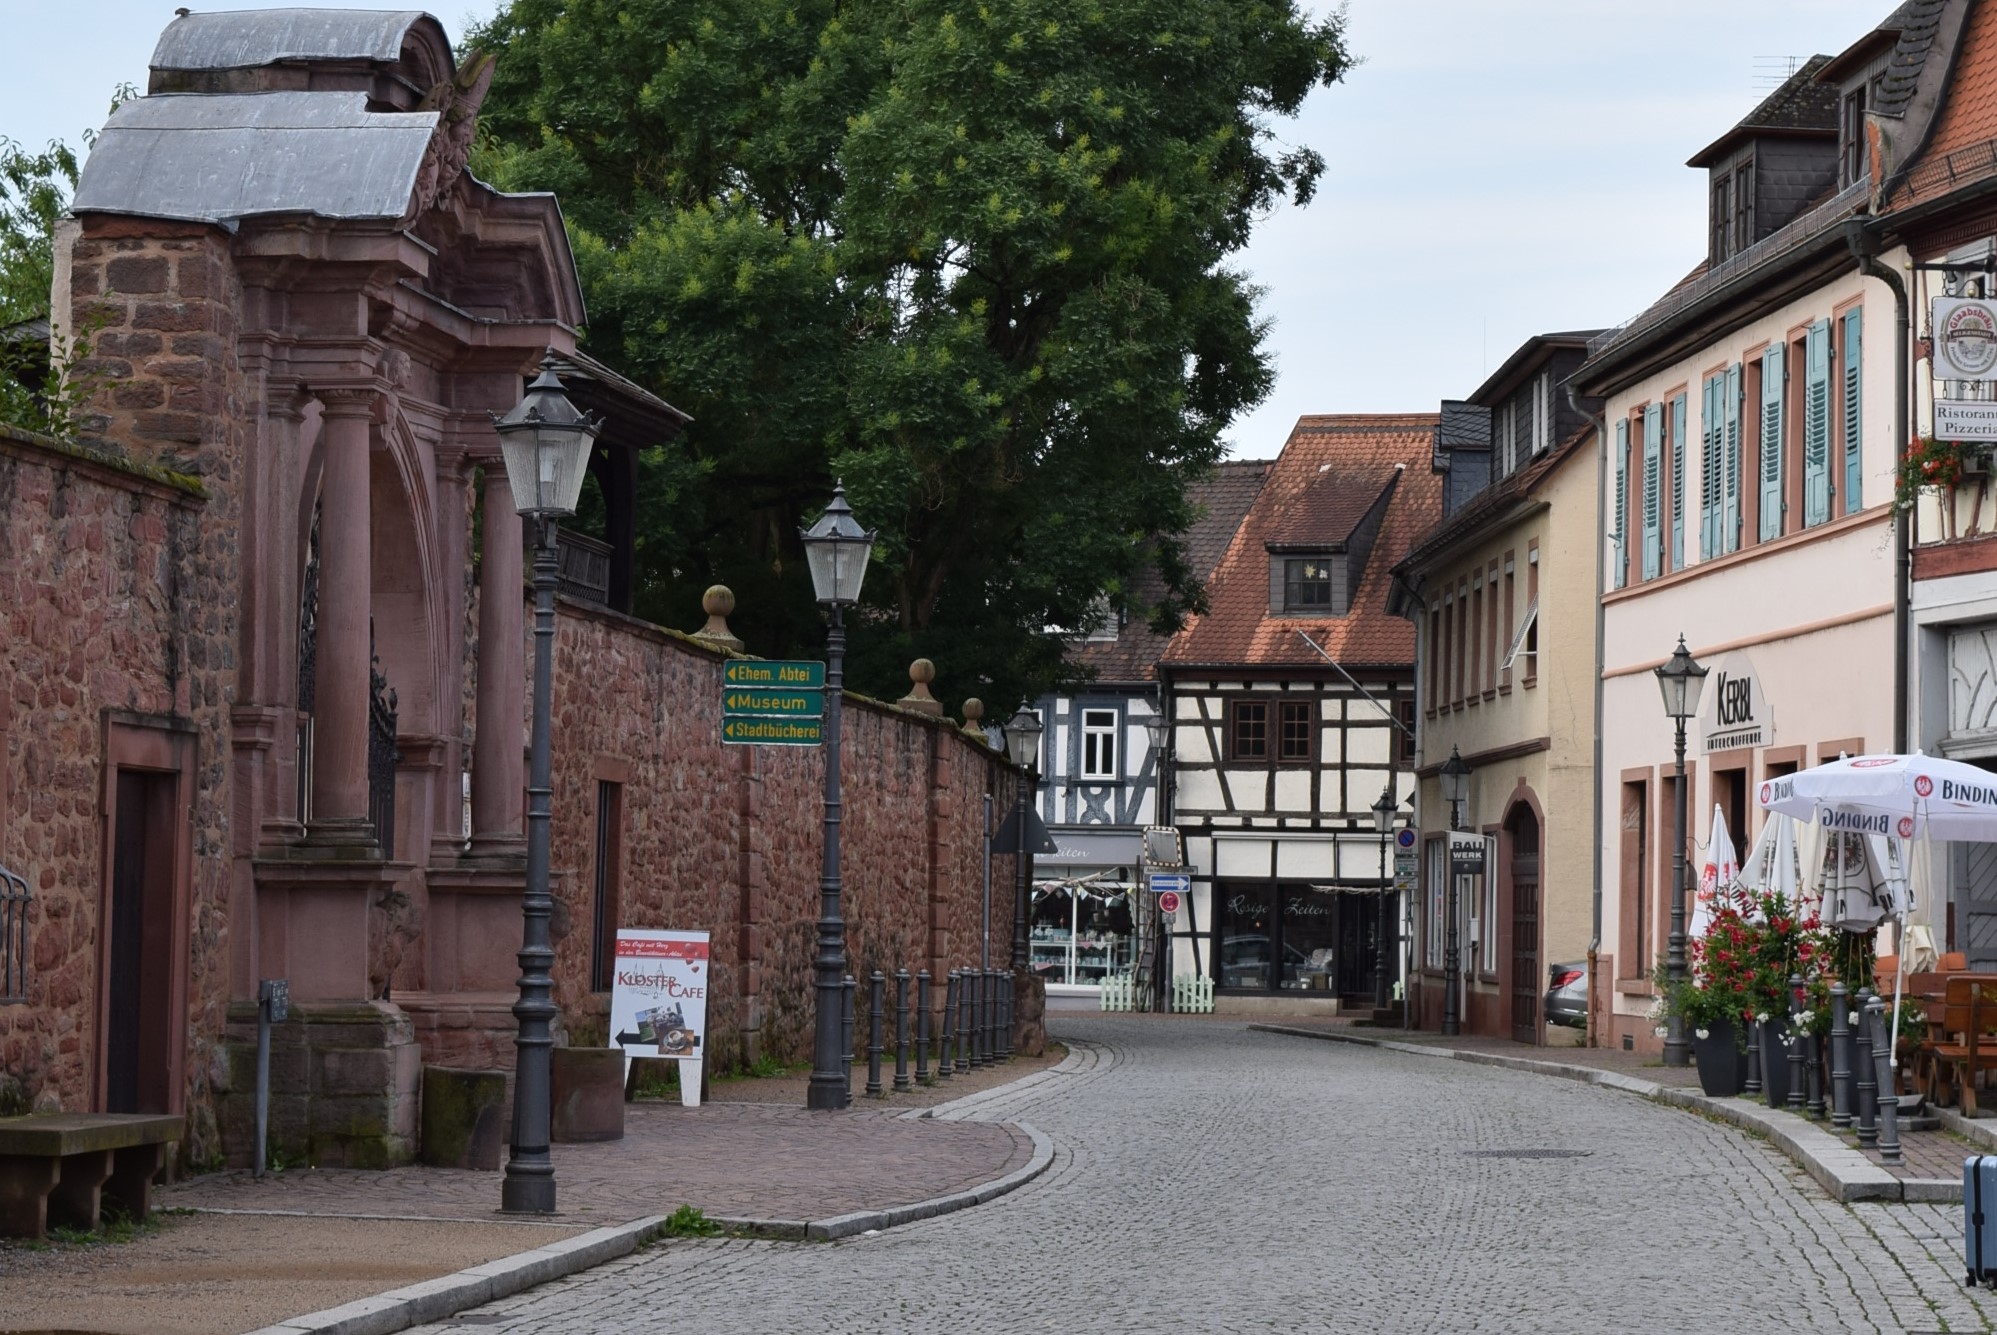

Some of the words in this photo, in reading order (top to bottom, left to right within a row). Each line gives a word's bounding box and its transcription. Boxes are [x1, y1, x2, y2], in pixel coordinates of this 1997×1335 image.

[1950, 307, 1993, 330] Glaabsbräu
[1937, 407, 1997, 419] Ristoran
[738, 665, 774, 681] Ehem.
[778, 667, 810, 681] Abtei
[737, 694, 807, 710] Museum
[1717, 671, 1754, 726] KERBL
[736, 722, 820, 738] Stadtbücherei
[1707, 731, 1761, 750] INTERCOIFFEURE
[1452, 841, 1482, 850] BAU
[1452, 851, 1482, 859] WERK
[1227, 894, 1269, 919] Rosige
[1284, 897, 1329, 916] Zeiten
[618, 971, 677, 987] KLOSTER
[668, 982, 704, 998] CAFE
